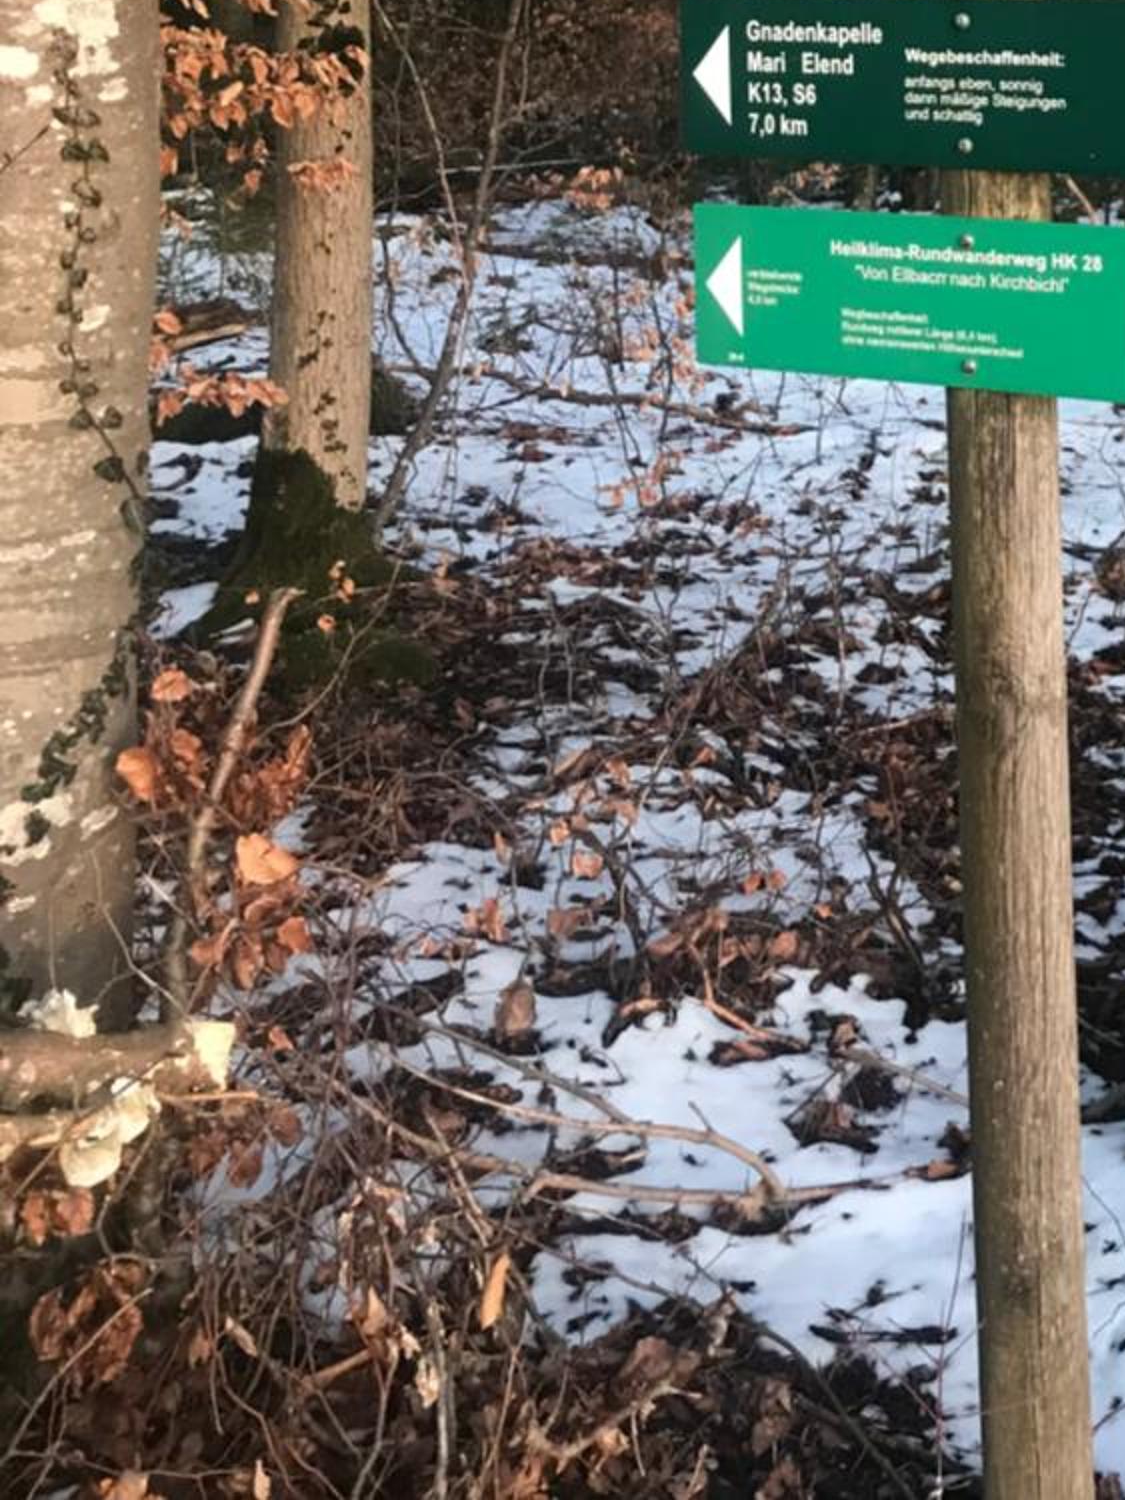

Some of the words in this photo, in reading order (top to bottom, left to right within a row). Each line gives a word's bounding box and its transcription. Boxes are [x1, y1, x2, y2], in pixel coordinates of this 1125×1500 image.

[745, 19, 884, 49] Gnadenkapelle
[801, 52, 855, 76] Elend
[904, 47, 1066, 68] Wegebeschaffenheit:
[747, 82, 789, 108] K13,
[792, 83, 817, 106] S6
[904, 75, 956, 92] anfangs
[958, 76, 996, 92] eben,
[998, 79, 1044, 96] sonnig
[904, 91, 938, 105] dann
[939, 91, 990, 110] mäßige
[991, 93, 1068, 113] Steigungen
[748, 113, 776, 138] 7,0
[780, 113, 809, 136] km
[904, 107, 930, 121] und
[932, 108, 984, 128] schattig
[830, 239, 1047, 273] Heilklima-Rundwanderweg
[1050, 252, 1078, 272] HK
[948, 270, 986, 288] nach
